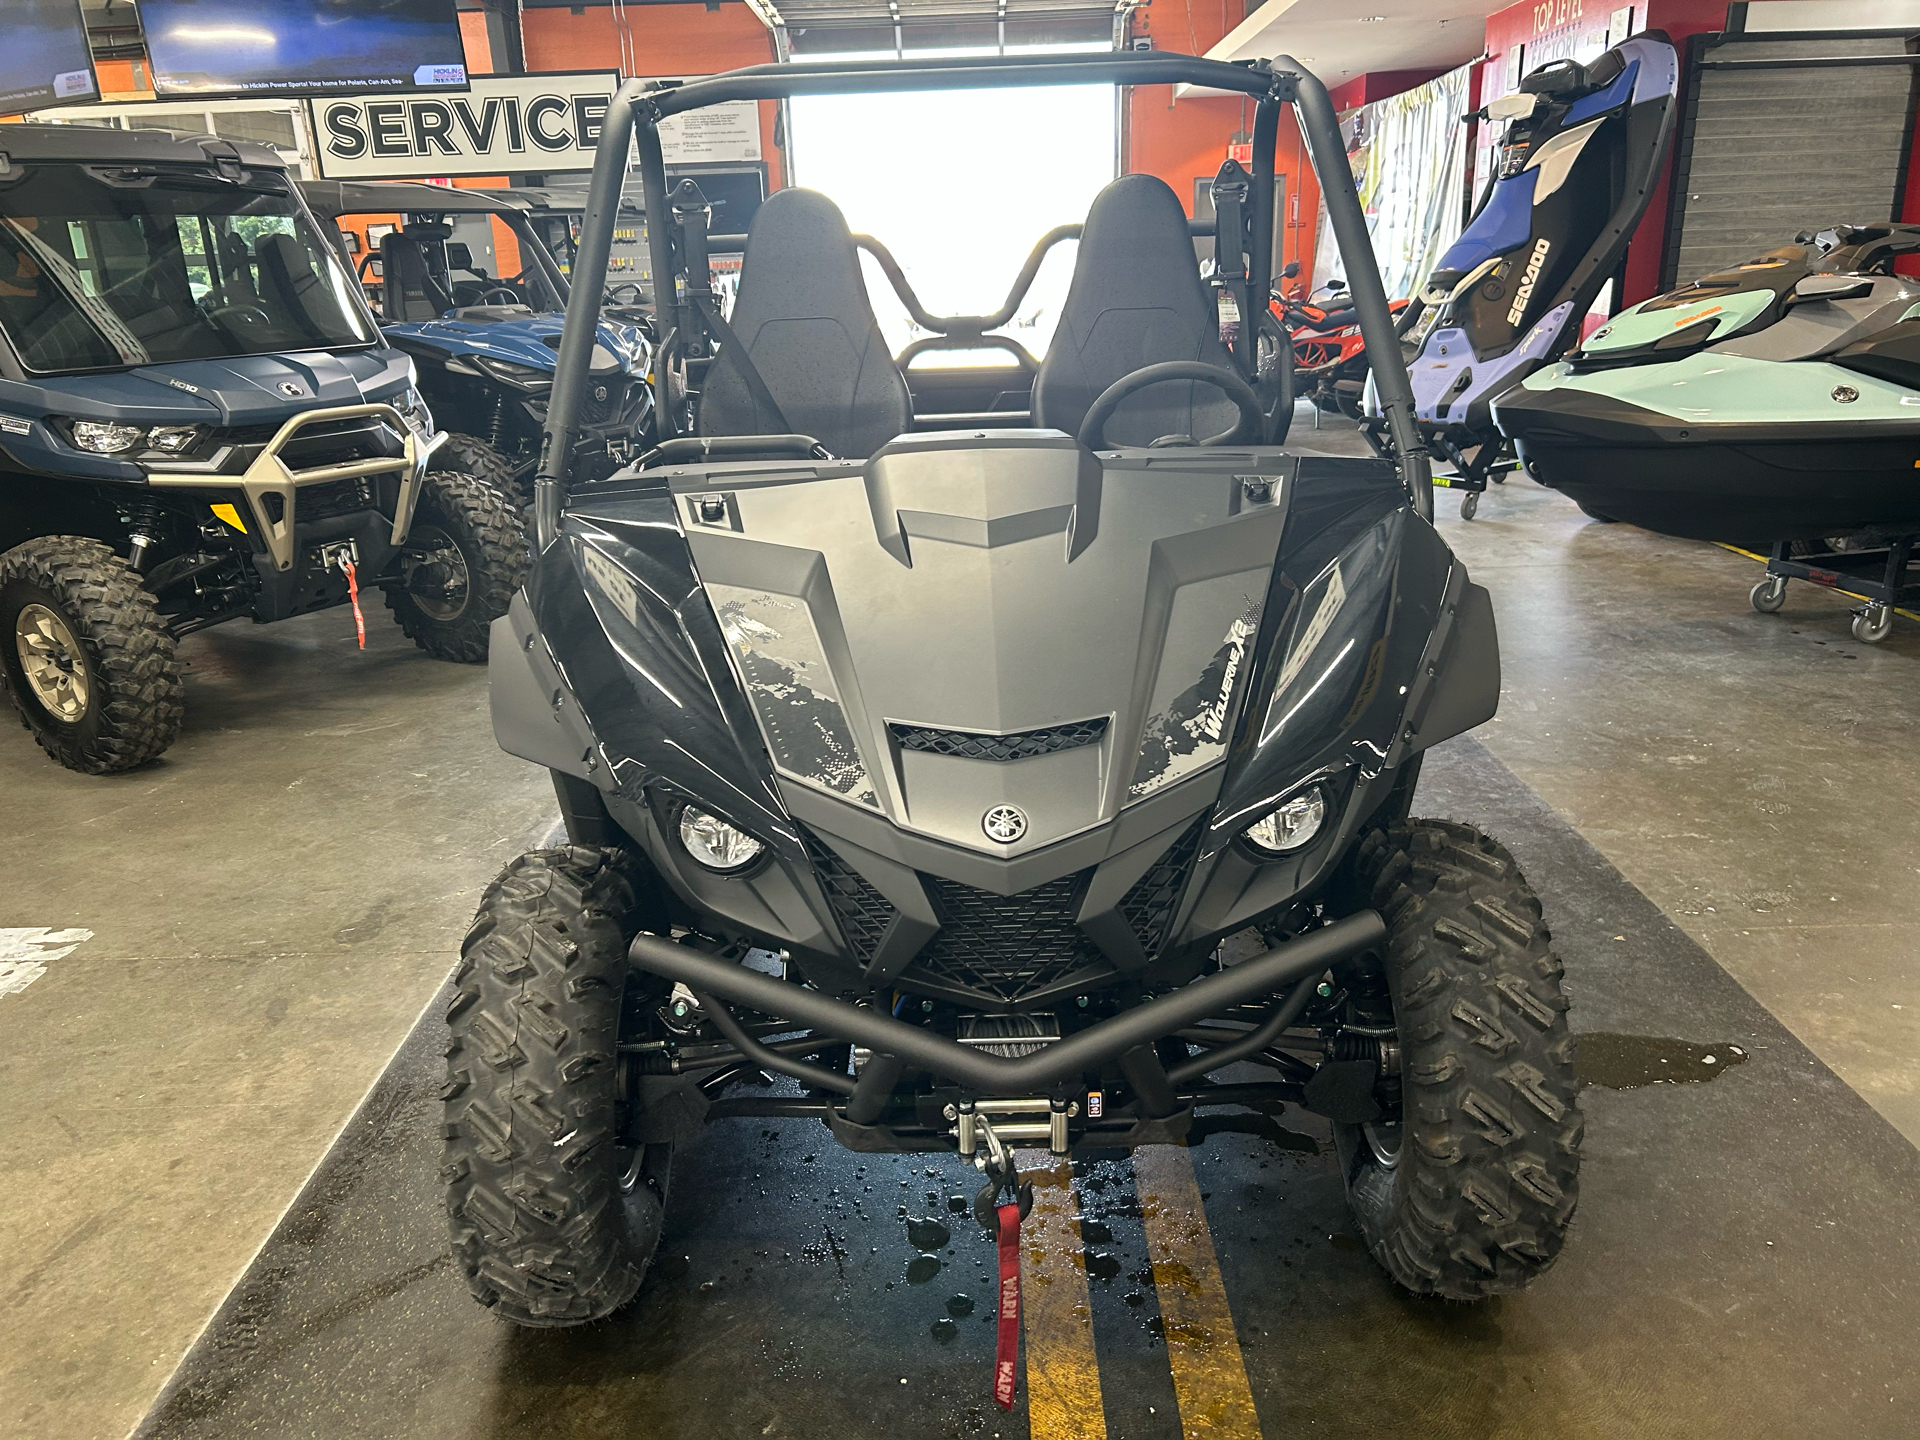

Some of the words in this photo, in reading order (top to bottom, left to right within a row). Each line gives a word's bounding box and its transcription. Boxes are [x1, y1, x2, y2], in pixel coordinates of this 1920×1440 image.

[1534, 3, 1554, 35] TOP
[1555, 0, 1583, 26] LEVEL
[1531, 33, 1579, 70] FACTORY
[324, 93, 612, 160] SERVICE
[169, 378, 199, 393] HD10
[1002, 1275, 1019, 1319] WARN
[997, 1361, 1014, 1404] WARN
